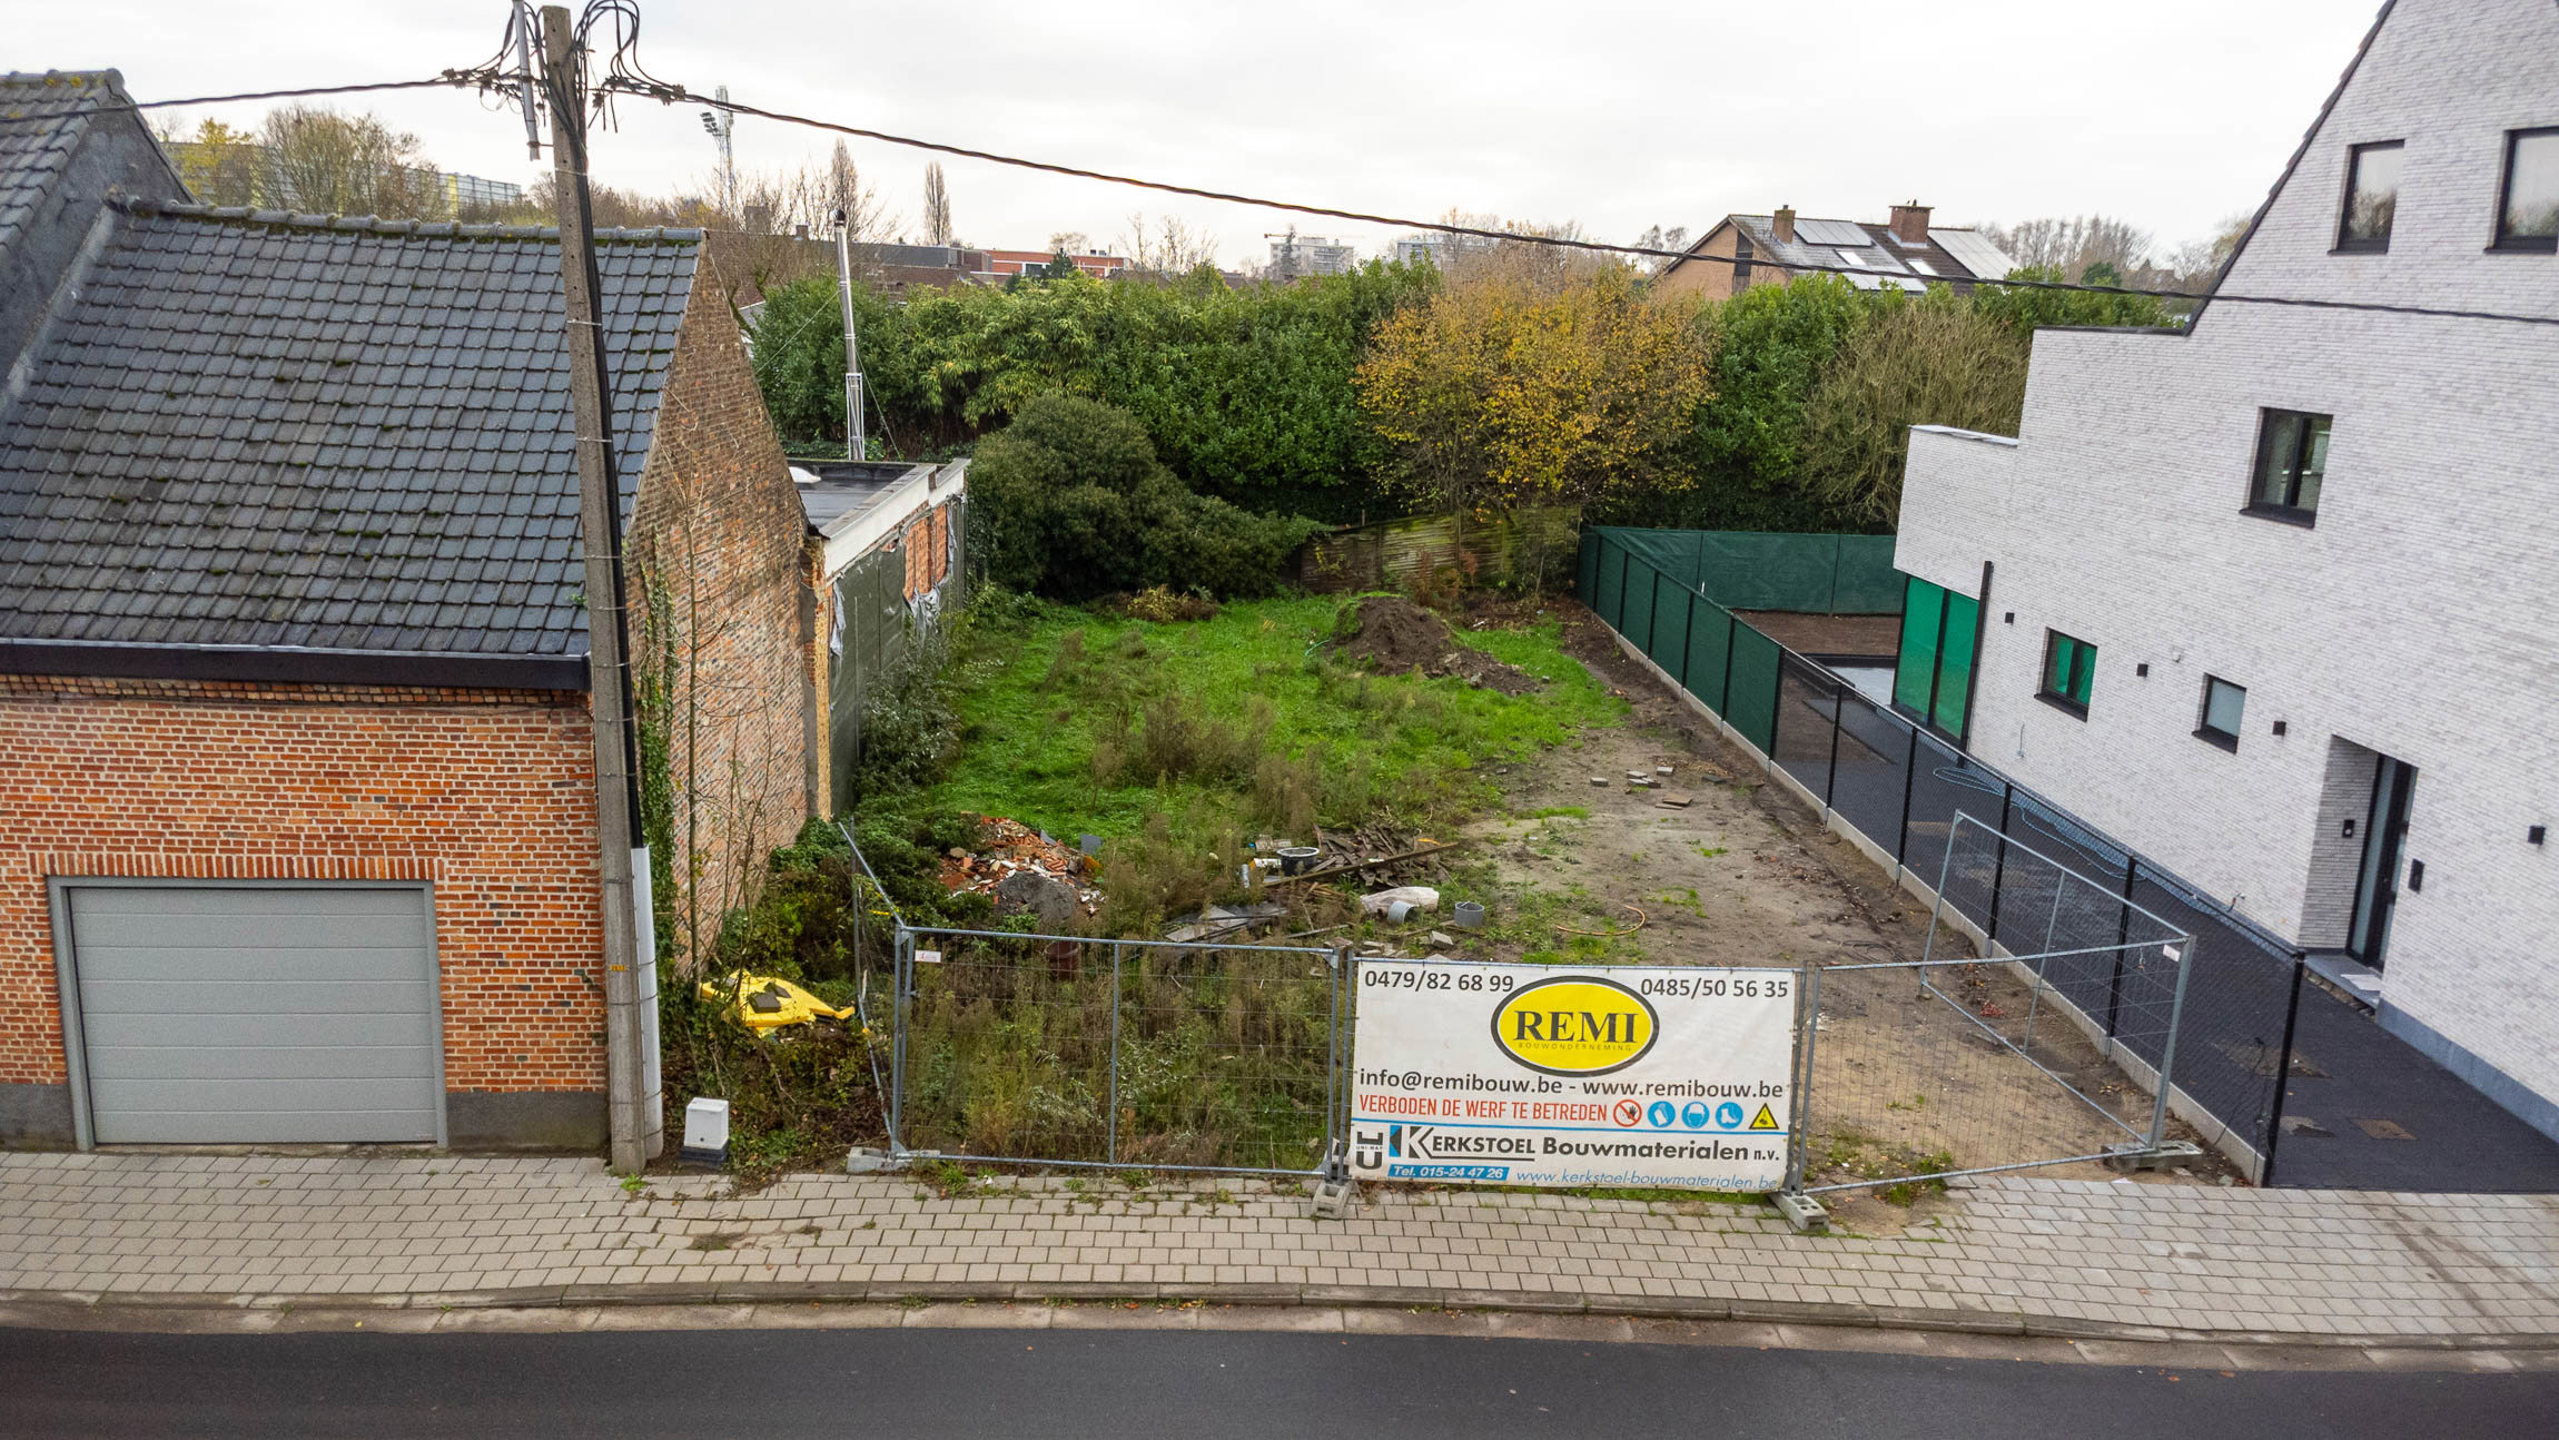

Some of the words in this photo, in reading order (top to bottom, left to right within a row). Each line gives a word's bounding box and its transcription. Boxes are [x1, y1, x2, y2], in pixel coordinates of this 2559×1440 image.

[1365, 970, 1451, 992] 0479/82
[1458, 974, 1483, 991] 68
[1489, 975, 1514, 992] 99
[1641, 978, 1726, 999] 0485/50
[1733, 980, 1758, 997] 56
[1764, 981, 1788, 998] 35
[1513, 1010, 1639, 1043] REMI
[1519, 1042, 1632, 1052] BOUWONDERNEMING
[1360, 1068, 1562, 1094] info@remibouw.be
[1582, 1080, 1783, 1098] www.remibouw.be
[1359, 1094, 1437, 1115] VERBODEN
[1442, 1099, 1460, 1117] DE
[1466, 1100, 1507, 1118] WERF
[1512, 1102, 1528, 1119] TE
[1533, 1102, 1607, 1121] BETREDEN
[1401, 1126, 1536, 1160] KERKSTOEL
[1543, 1137, 1748, 1160] Bouwmaterialen
[1754, 1150, 1779, 1161] n.v.
[1394, 1166, 1416, 1177] Tel.
[1420, 1166, 1465, 1177] 015-24
[1468, 1167, 1483, 1178] 47
[1486, 1168, 1504, 1179] 26
[1517, 1168, 1777, 1189] www.kerkstoel-bouwmaterialen.be
